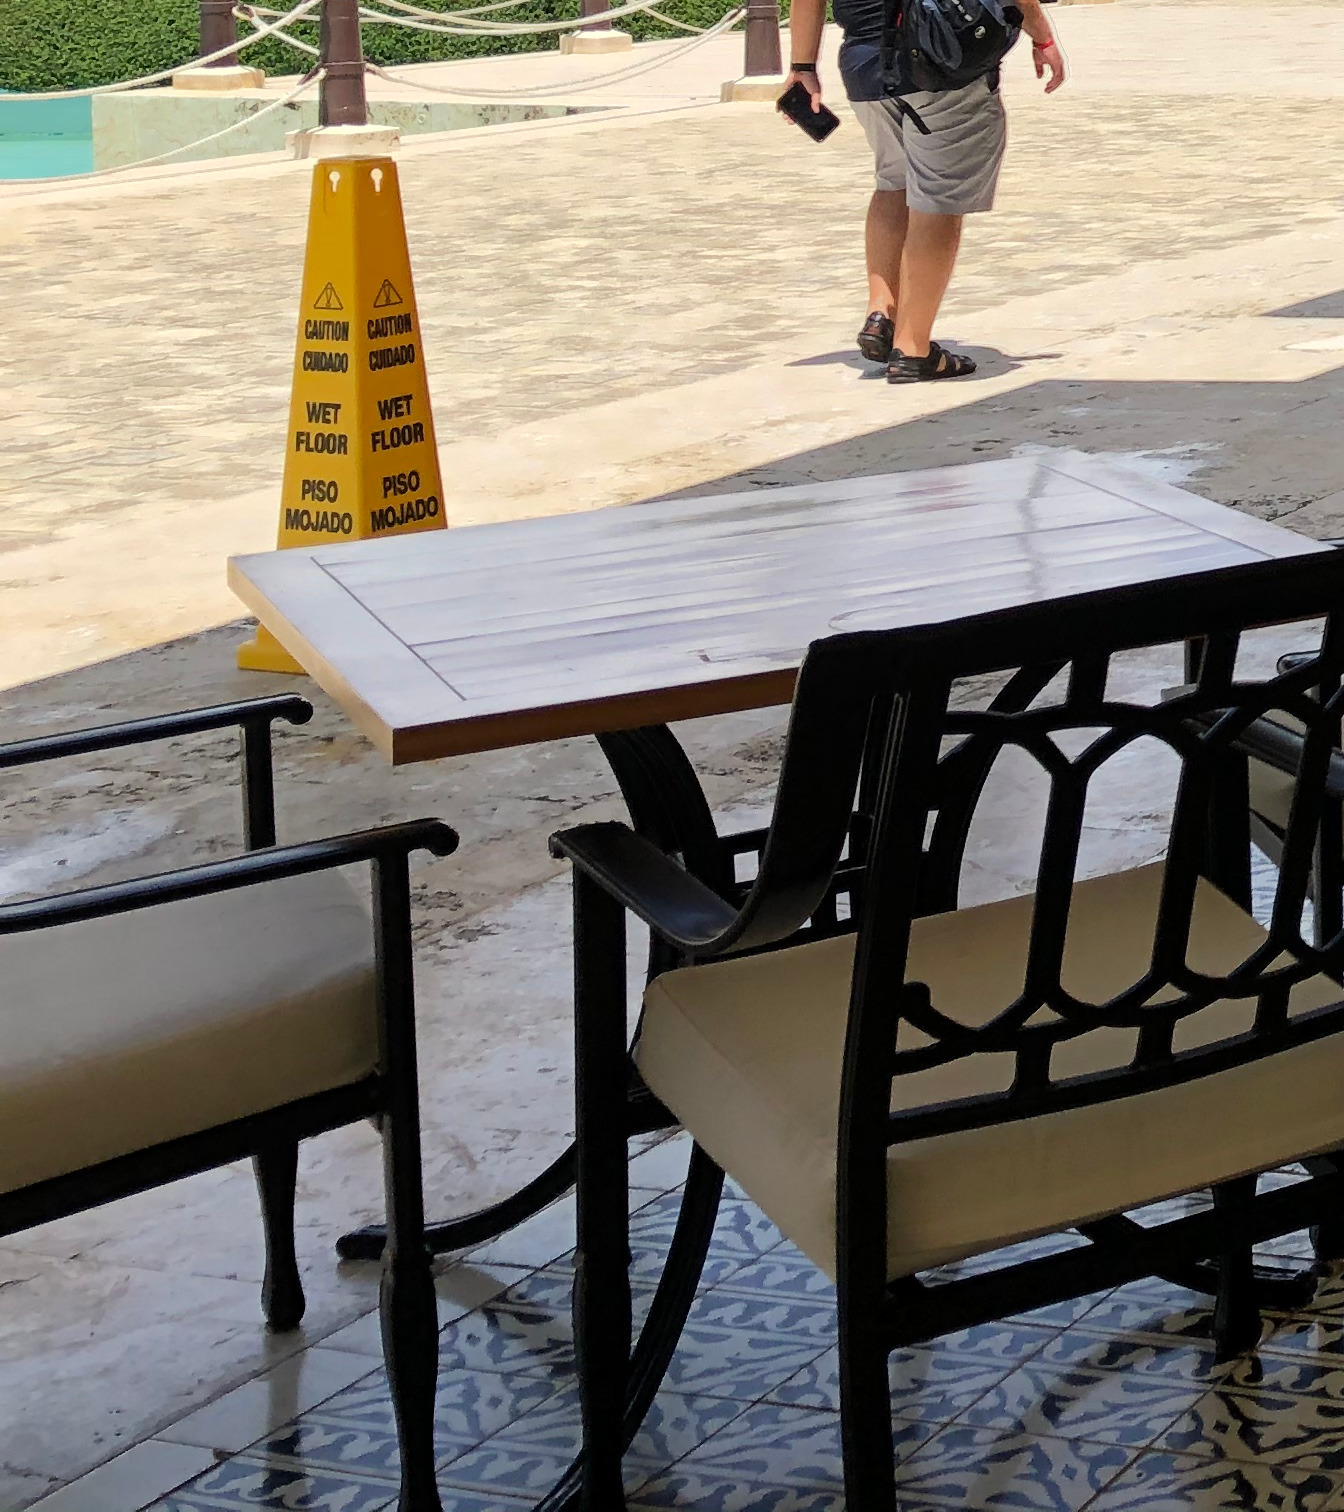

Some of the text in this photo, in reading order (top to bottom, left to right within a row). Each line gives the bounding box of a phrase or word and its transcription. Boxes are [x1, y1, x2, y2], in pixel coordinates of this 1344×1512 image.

[305, 319, 349, 341] CAUTION
[367, 313, 412, 339] CAUTION
[303, 350, 348, 373] CUIDADO
[368, 343, 415, 371] CUIDADO
[306, 401, 341, 425] WET
[377, 394, 413, 421] WET
[295, 431, 348, 455] FLOOR
[371, 422, 425, 452] FLOOR
[301, 479, 338, 503] PISO
[382, 470, 420, 499] PISO
[285, 508, 353, 534] MOJADO
[371, 496, 439, 532] MOJADO
